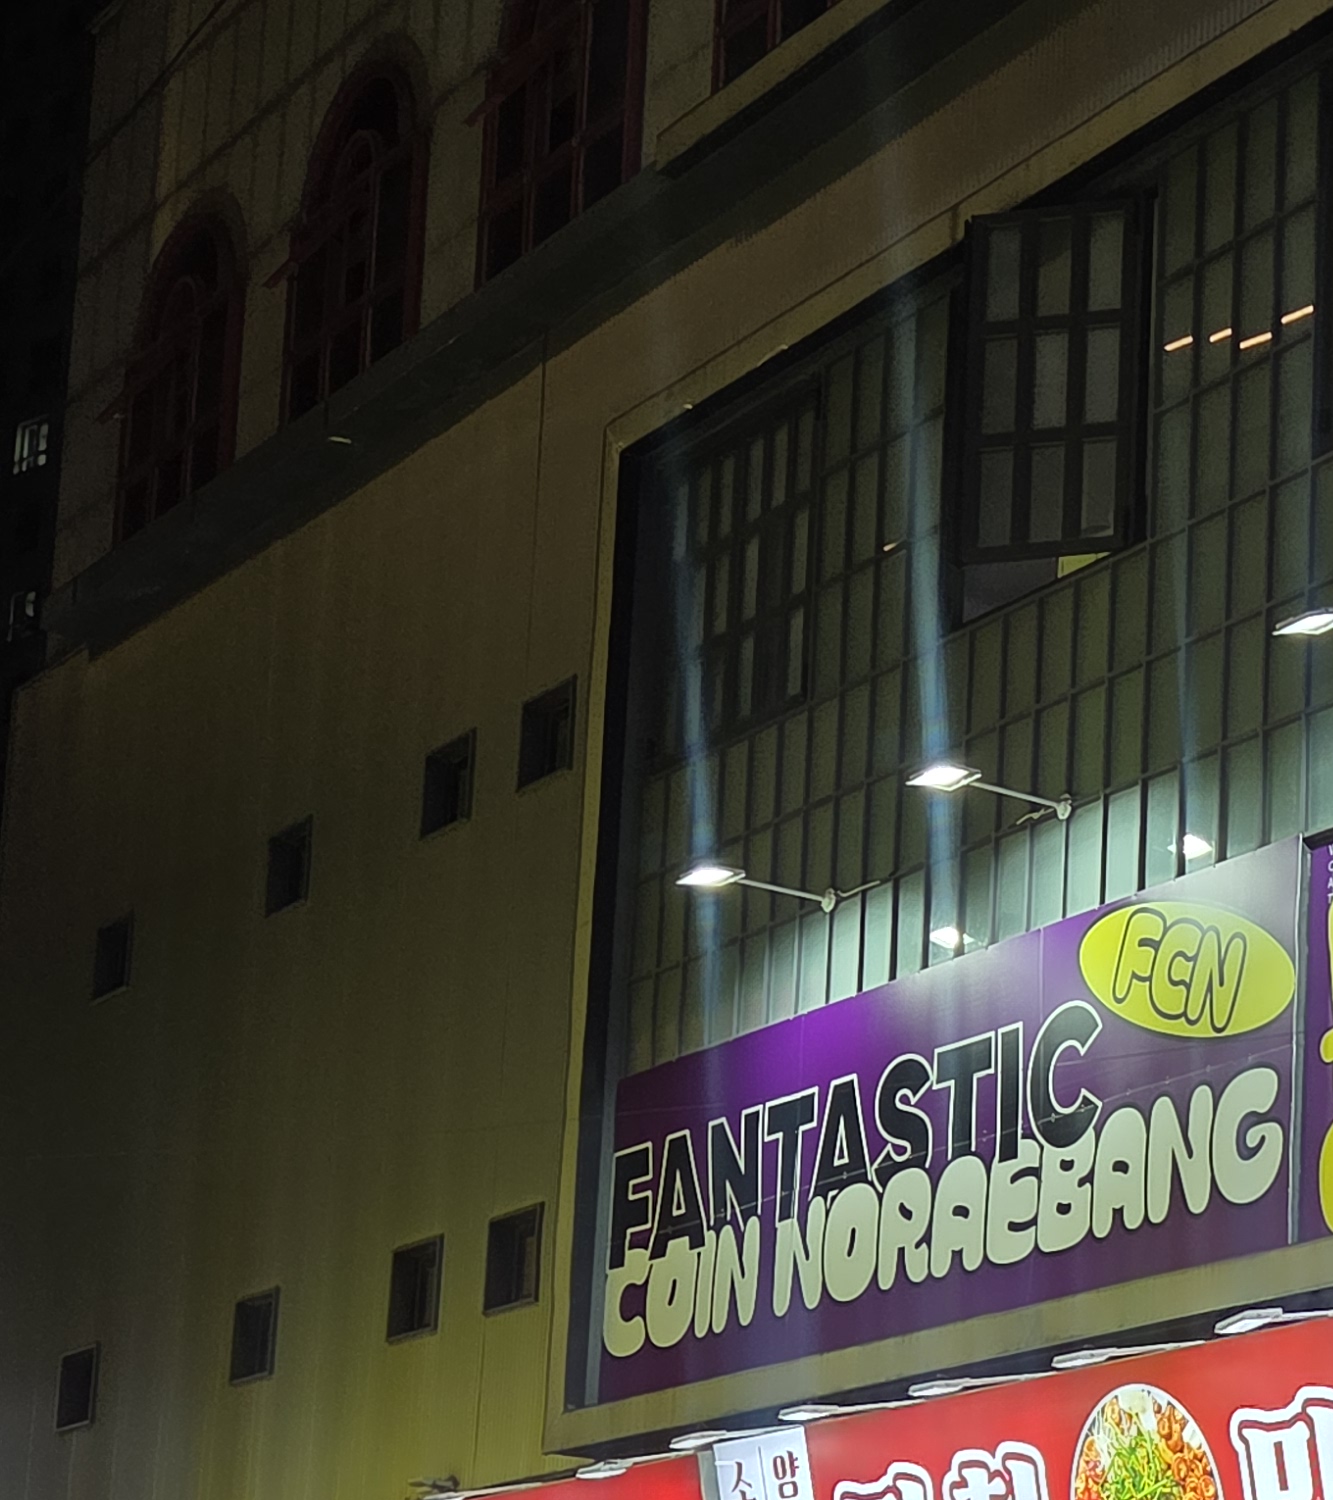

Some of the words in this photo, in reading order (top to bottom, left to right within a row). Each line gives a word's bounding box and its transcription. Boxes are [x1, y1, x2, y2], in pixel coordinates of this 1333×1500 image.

[1113, 908, 1246, 1033] FCN
[603, 1220, 760, 1357] COIN
[773, 1066, 1284, 1317] NORAEBANG
[608, 1000, 1103, 1270] FANTASTIC
